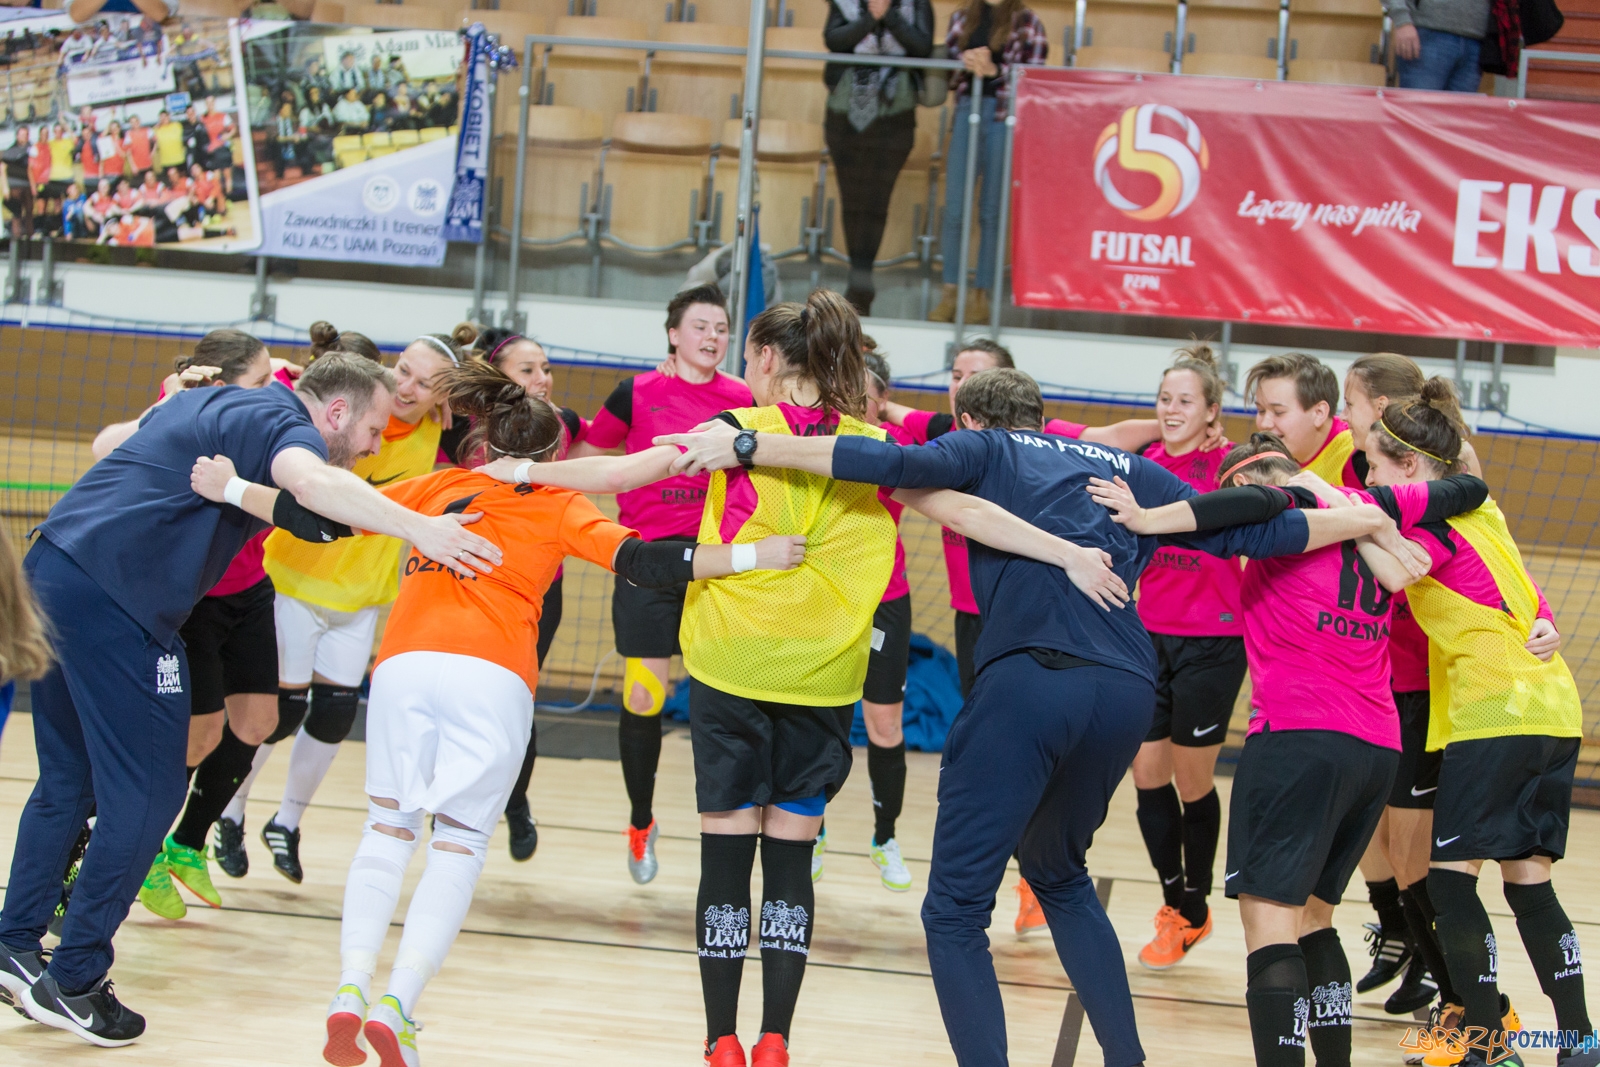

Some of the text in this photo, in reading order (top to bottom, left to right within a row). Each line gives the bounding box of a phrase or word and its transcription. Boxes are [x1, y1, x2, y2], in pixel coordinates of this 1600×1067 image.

[373, 38, 419, 53] Adam
[463, 79, 484, 160] KOBIET
[284, 211, 376, 232] Zawodniczki
[1237, 190, 1422, 236] Łączy nas piłka
[1452, 178, 1600, 278] EKS
[282, 231, 437, 256] KU AZS UAM Poznań
[1090, 230, 1196, 267] FUTSAL
[1009, 432, 1053, 449] UAM
[157, 685, 183, 694] FUTSAL
[705, 927, 747, 948] UAM
[761, 920, 806, 943] UAM
